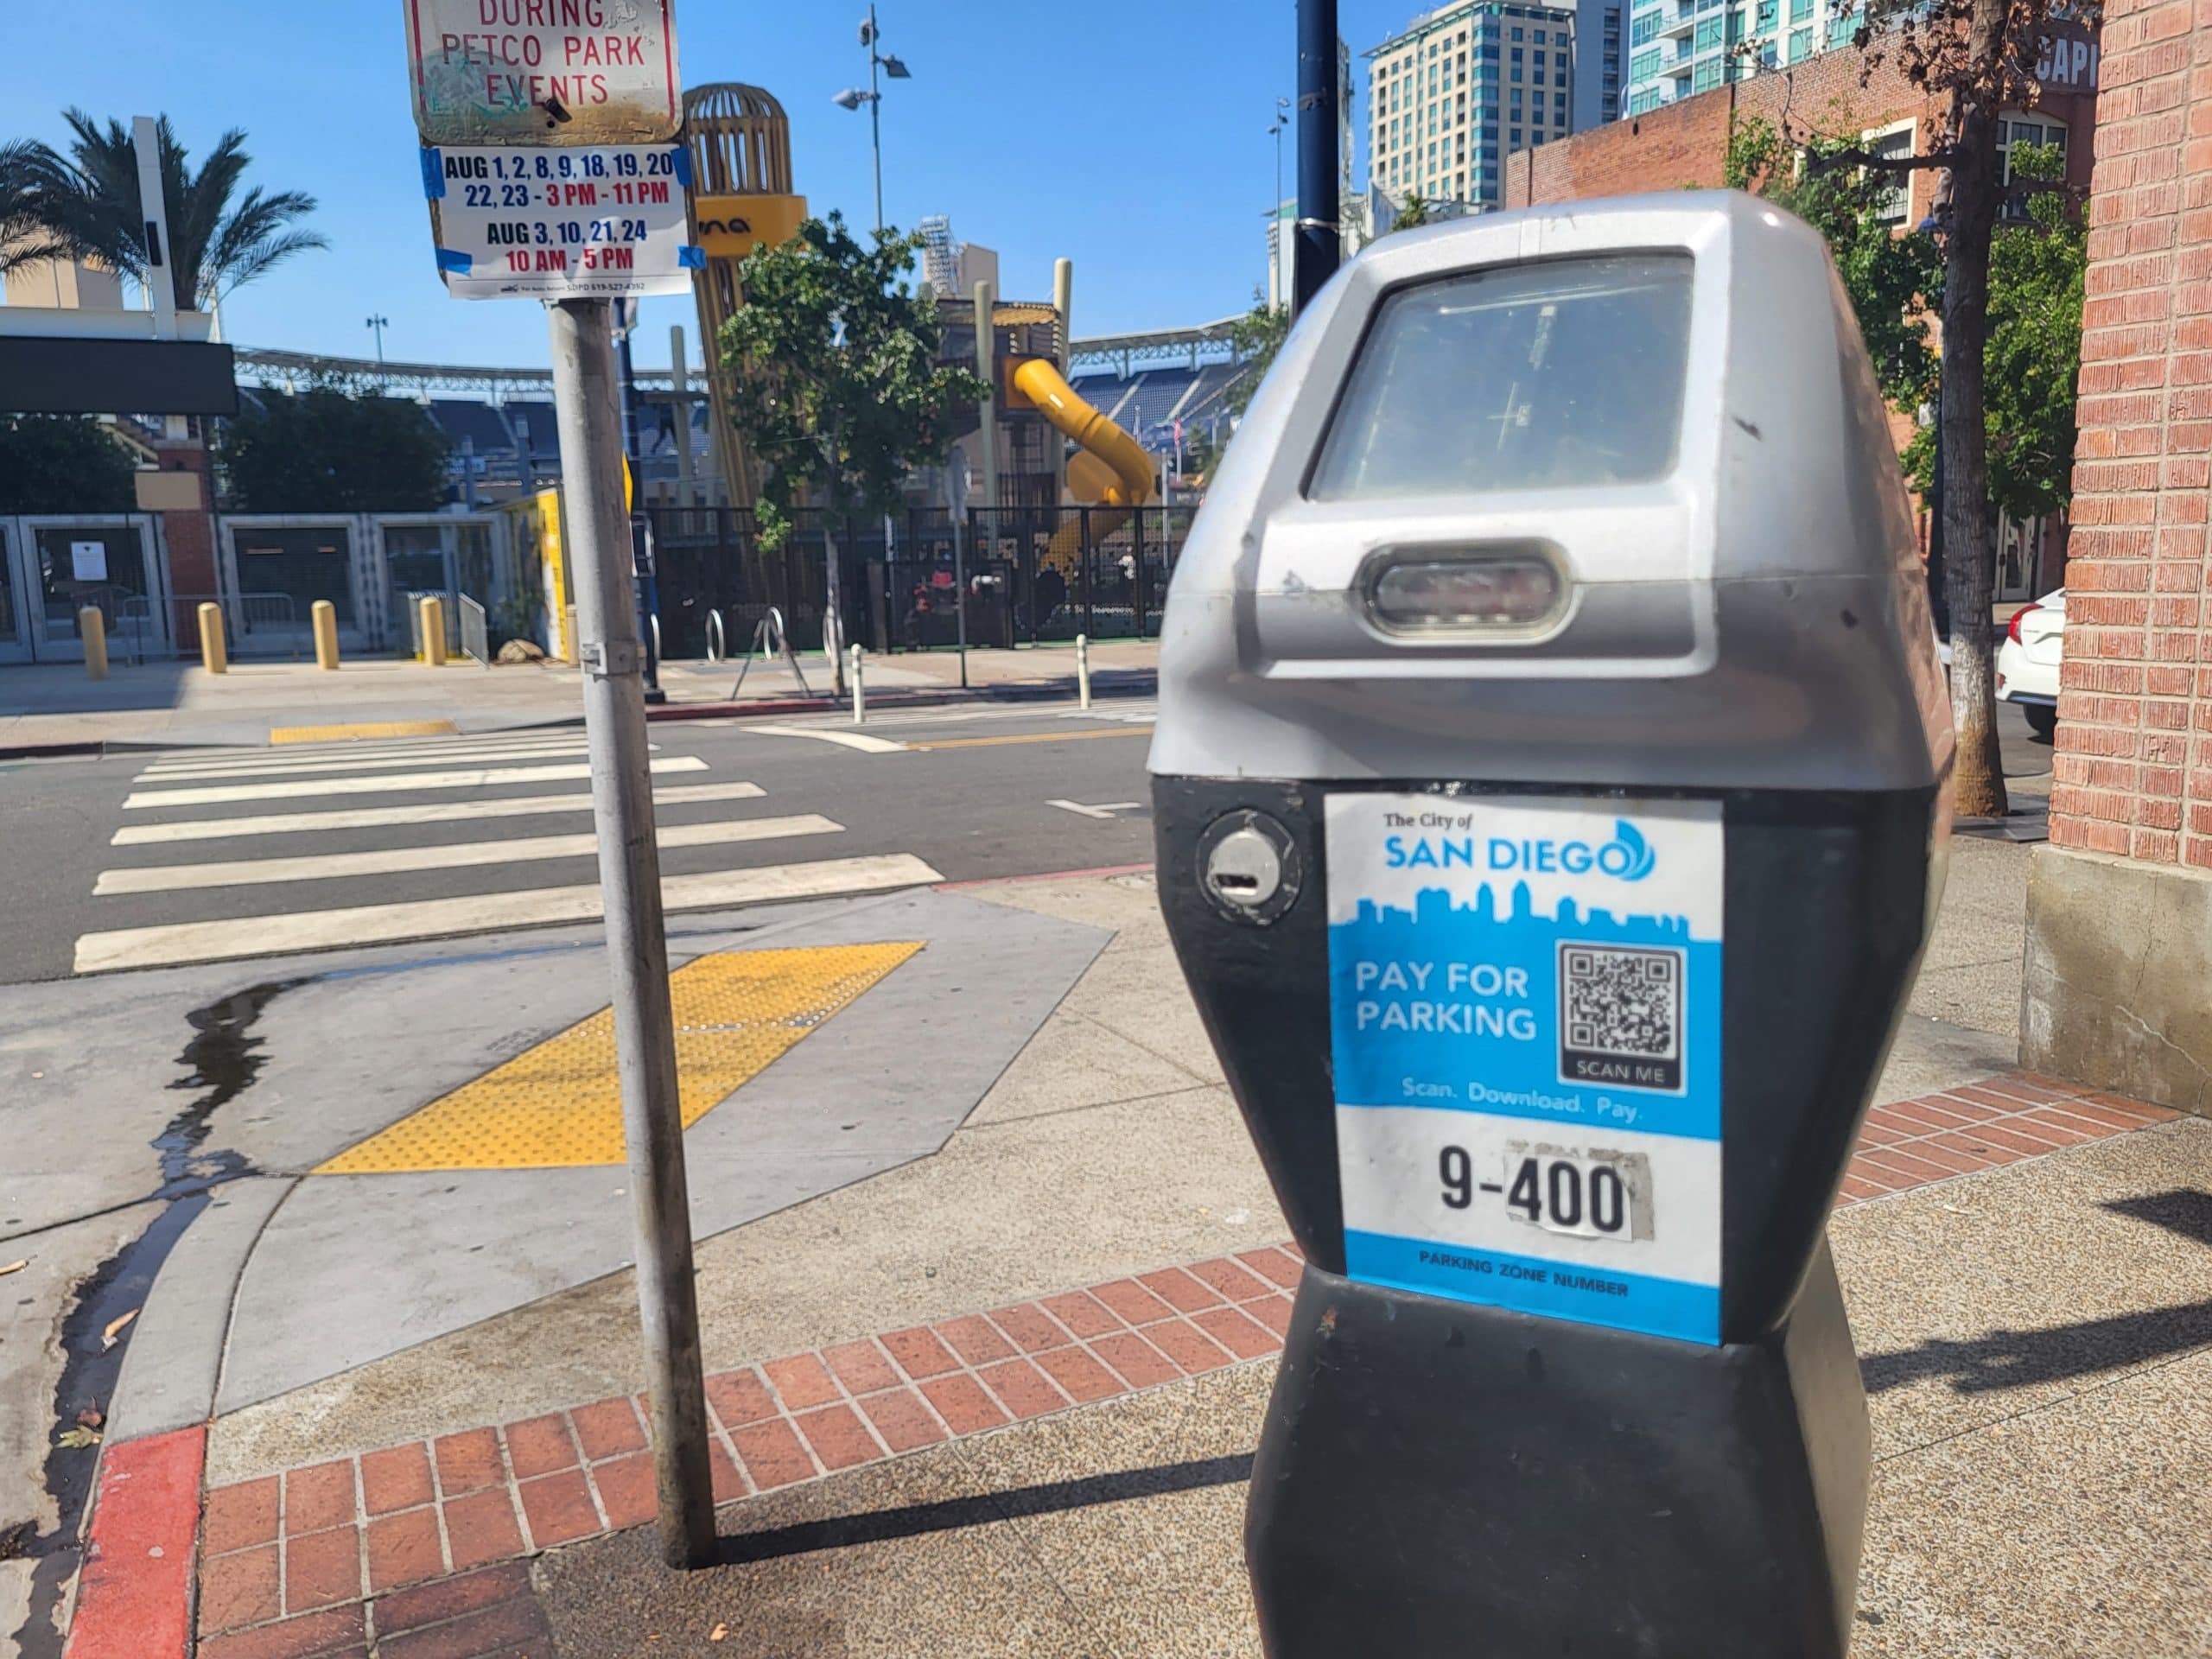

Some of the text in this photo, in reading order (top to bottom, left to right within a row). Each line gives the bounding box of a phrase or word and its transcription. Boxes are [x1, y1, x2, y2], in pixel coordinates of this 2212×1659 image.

[479, 0, 604, 27] DURING
[442, 33, 645, 67] PETCO PARK
[2034, 35, 2098, 87] CAPI
[486, 73, 608, 106] EVENTS
[445, 152, 674, 181] AUG 1, 2, 8, 9, 18, 19, 20
[465, 184, 498, 208] 22,
[501, 183, 529, 207] 23
[546, 183, 560, 207] 3
[564, 182, 597, 207] PM
[613, 182, 633, 205] 11
[637, 181, 670, 205] PM
[487, 219, 647, 245] AUG 3, 10, 21, 24
[698, 218, 751, 235] na
[505, 250, 530, 272] 10
[536, 249, 567, 272] AM
[583, 248, 597, 270] 5
[601, 247, 633, 270] PM
[1383, 812, 1473, 831] The City of
[1384, 835, 1632, 877] SAN DIEGO
[1355, 961, 1529, 999] PAY FOR
[1357, 1000, 1537, 1041] PARKING
[1576, 1059, 1665, 1084] SCAN ME
[1402, 1077, 1458, 1099] Scan.
[1468, 1082, 1586, 1114] Download.
[1438, 1144, 1624, 1233] 9-400
[1418, 1249, 1630, 1298] PARKING ZONE NUMBER
